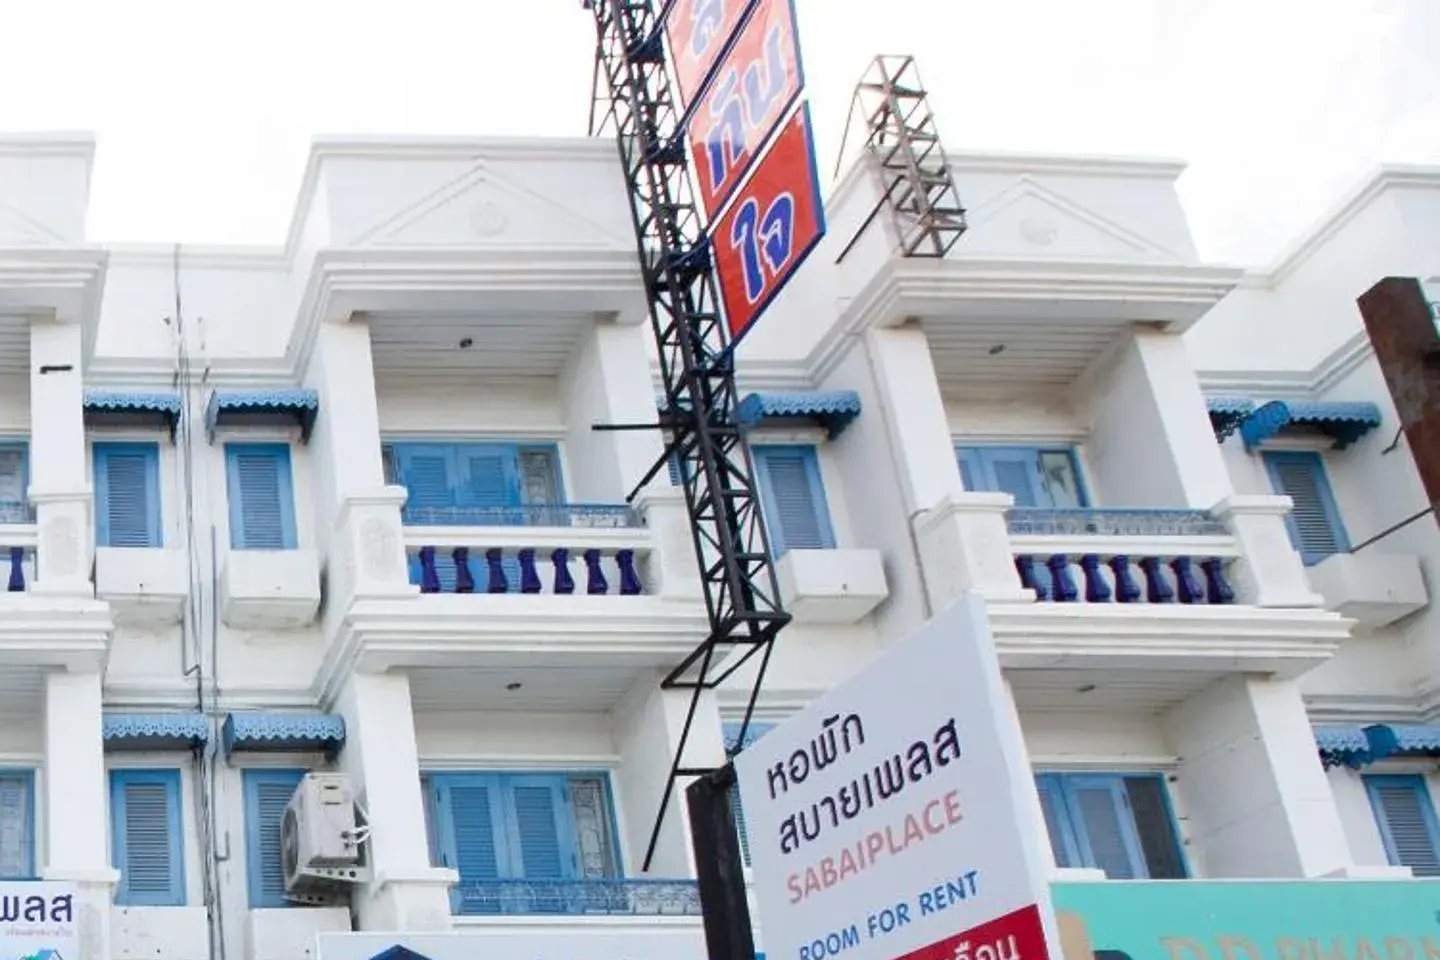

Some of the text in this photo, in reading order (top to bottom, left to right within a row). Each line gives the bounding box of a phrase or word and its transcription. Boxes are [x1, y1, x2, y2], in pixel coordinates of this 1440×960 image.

[766, 712, 866, 800] หอพัก
[778, 718, 962, 854] สบายเพลส
[784, 789, 965, 904] SABAIPLACE
[866, 902, 911, 938] FOR
[918, 869, 980, 917] RENT
